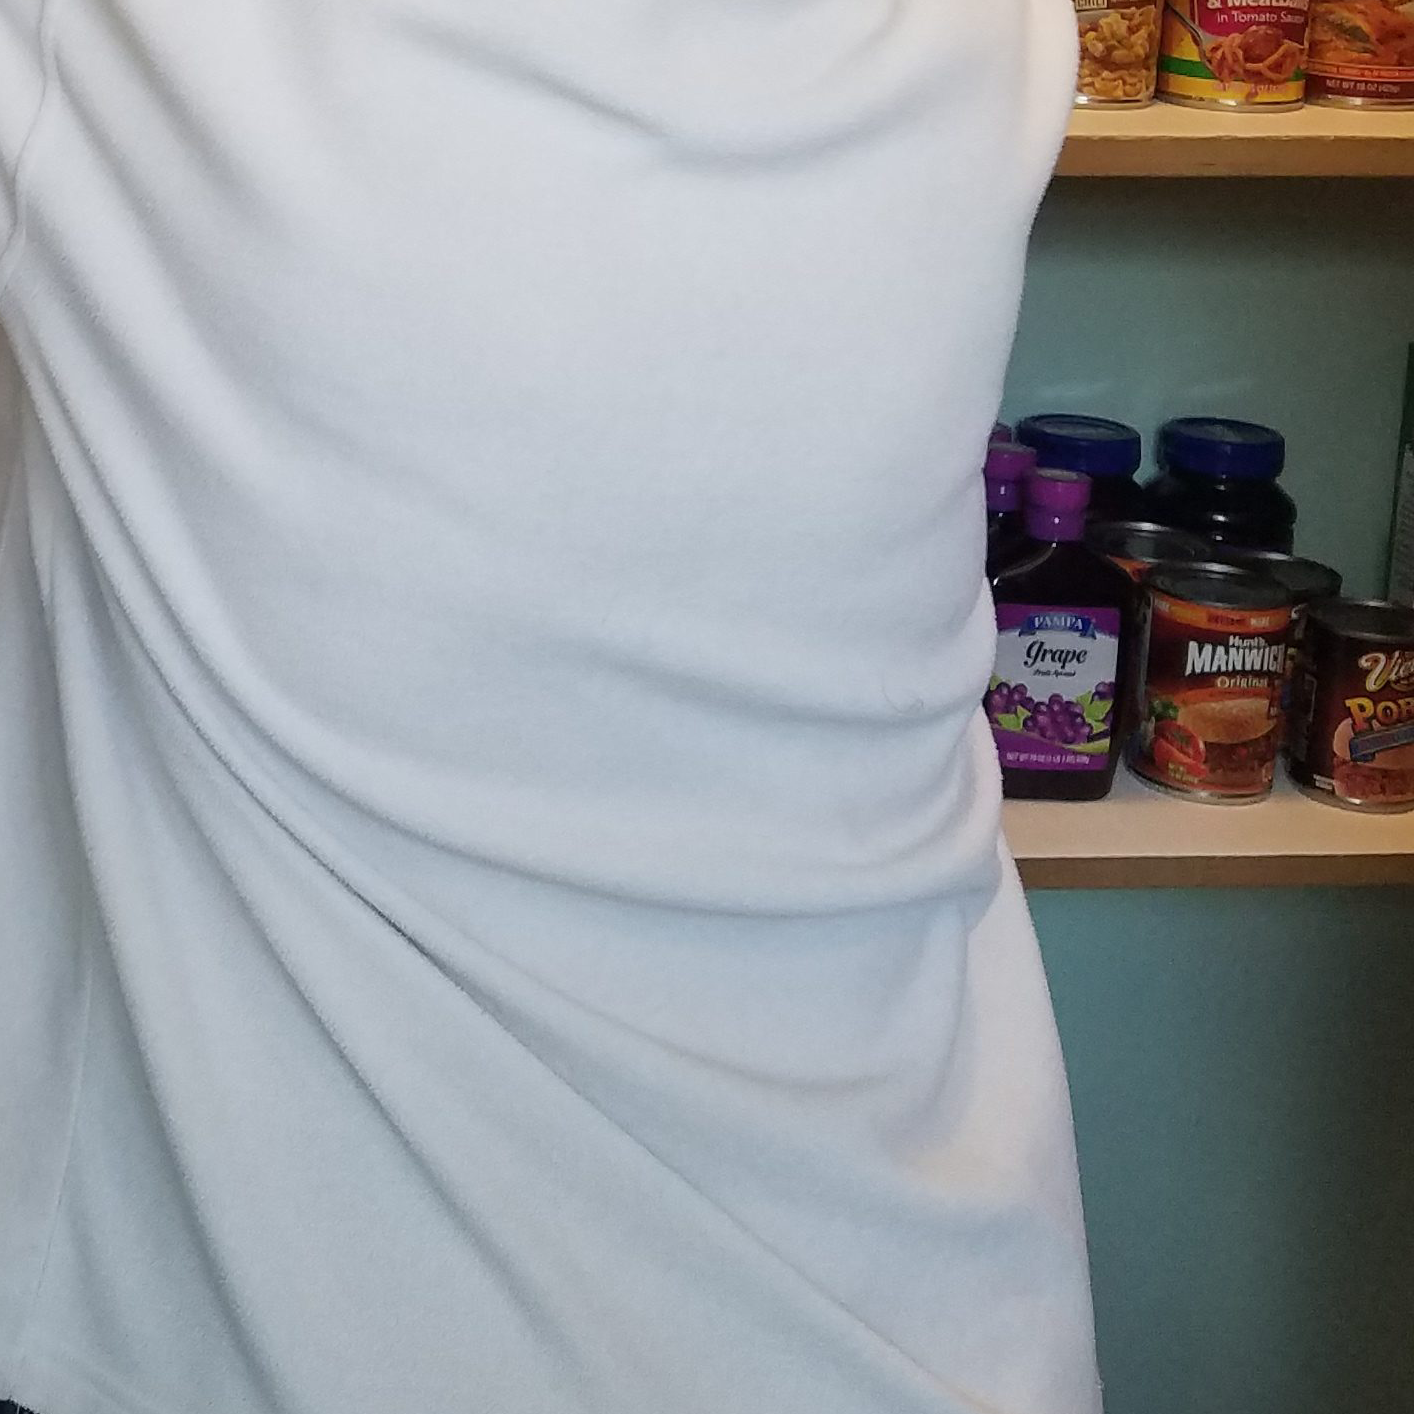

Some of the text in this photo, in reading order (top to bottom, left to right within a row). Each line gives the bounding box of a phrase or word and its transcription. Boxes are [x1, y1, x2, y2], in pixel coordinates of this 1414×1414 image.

[1217, 12, 1229, 23] in
[1231, 10, 1279, 23] Tomato
[1022, 639, 1089, 670] Grape
[1185, 640, 1287, 677] MANWICH
[1217, 675, 1270, 690] Original
[1343, 696, 1414, 732] POR
